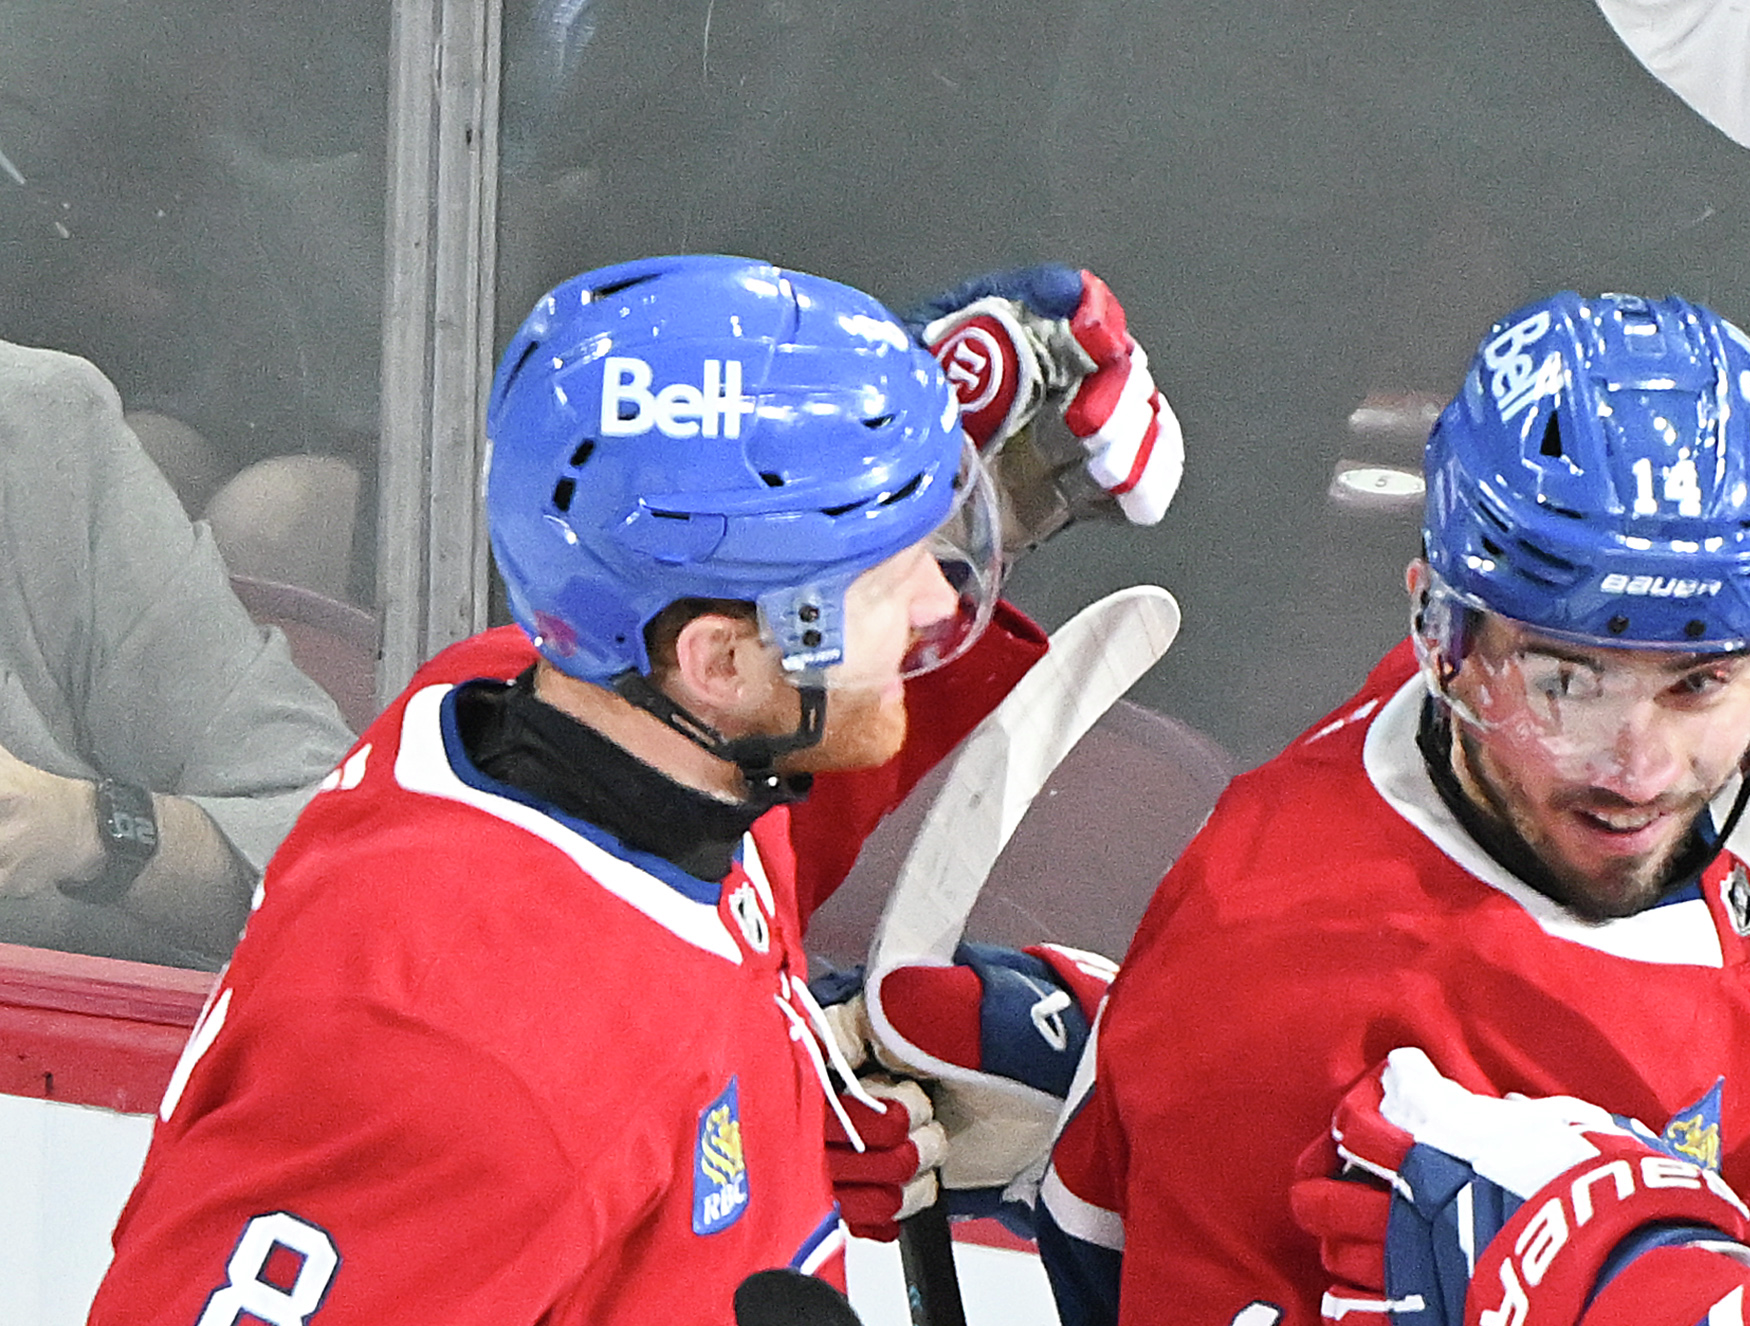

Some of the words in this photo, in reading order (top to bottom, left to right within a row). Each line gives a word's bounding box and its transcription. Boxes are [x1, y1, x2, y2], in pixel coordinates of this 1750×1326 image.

[601, 357, 742, 440] Bell
[1631, 457, 1702, 517] 14
[1600, 573, 1723, 598] BAUER
[703, 1170, 748, 1226] RBC
